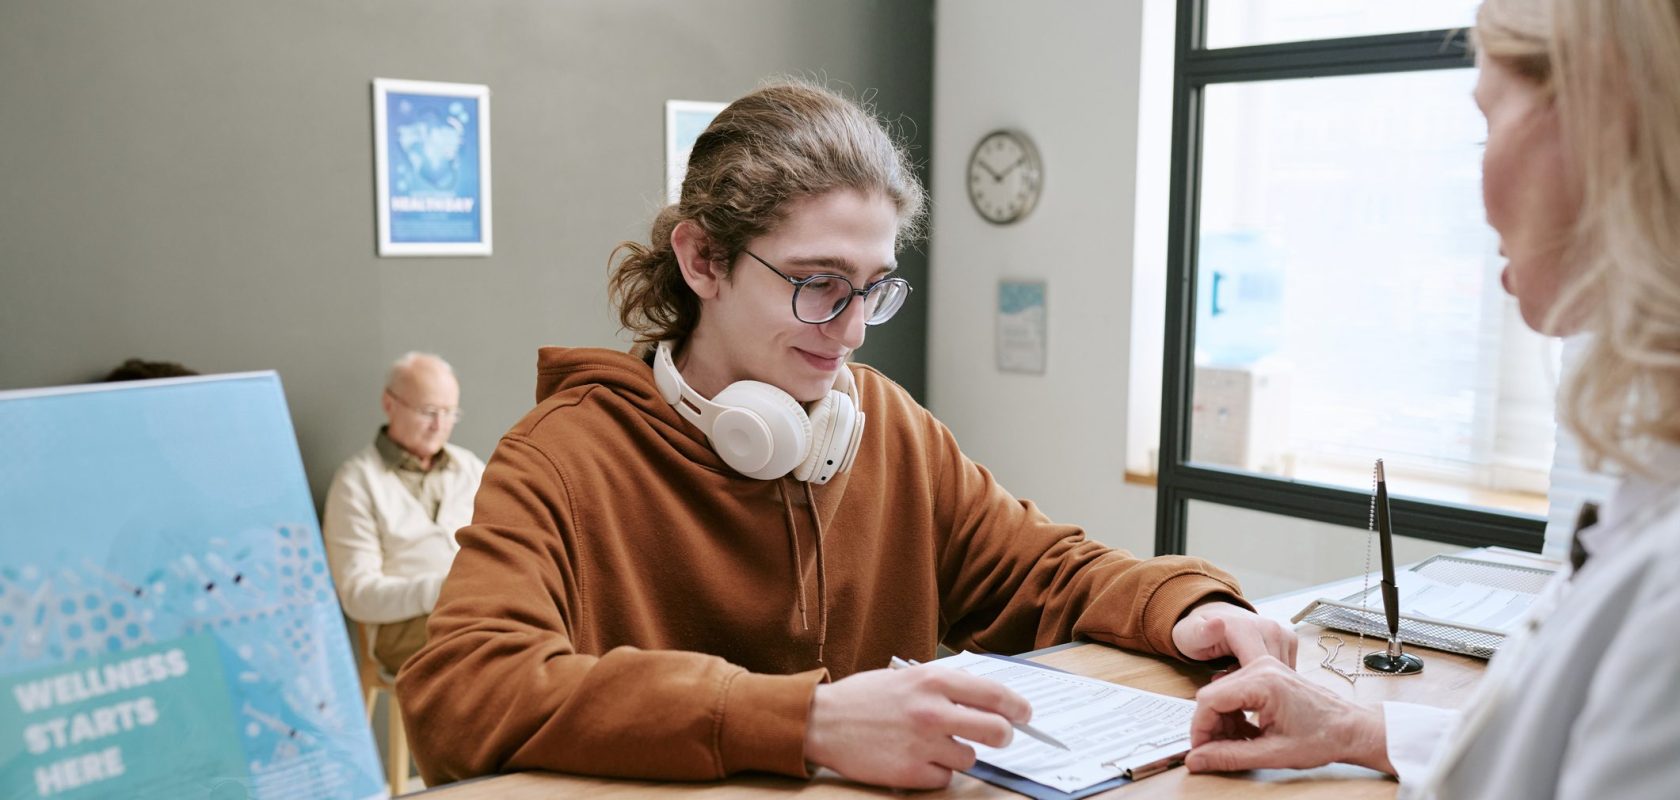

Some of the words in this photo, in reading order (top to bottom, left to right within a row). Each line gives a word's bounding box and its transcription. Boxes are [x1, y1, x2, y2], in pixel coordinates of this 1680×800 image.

[13, 649, 188, 713] WELLNESS
[24, 697, 158, 755] STARTS
[34, 746, 126, 797] HERE
